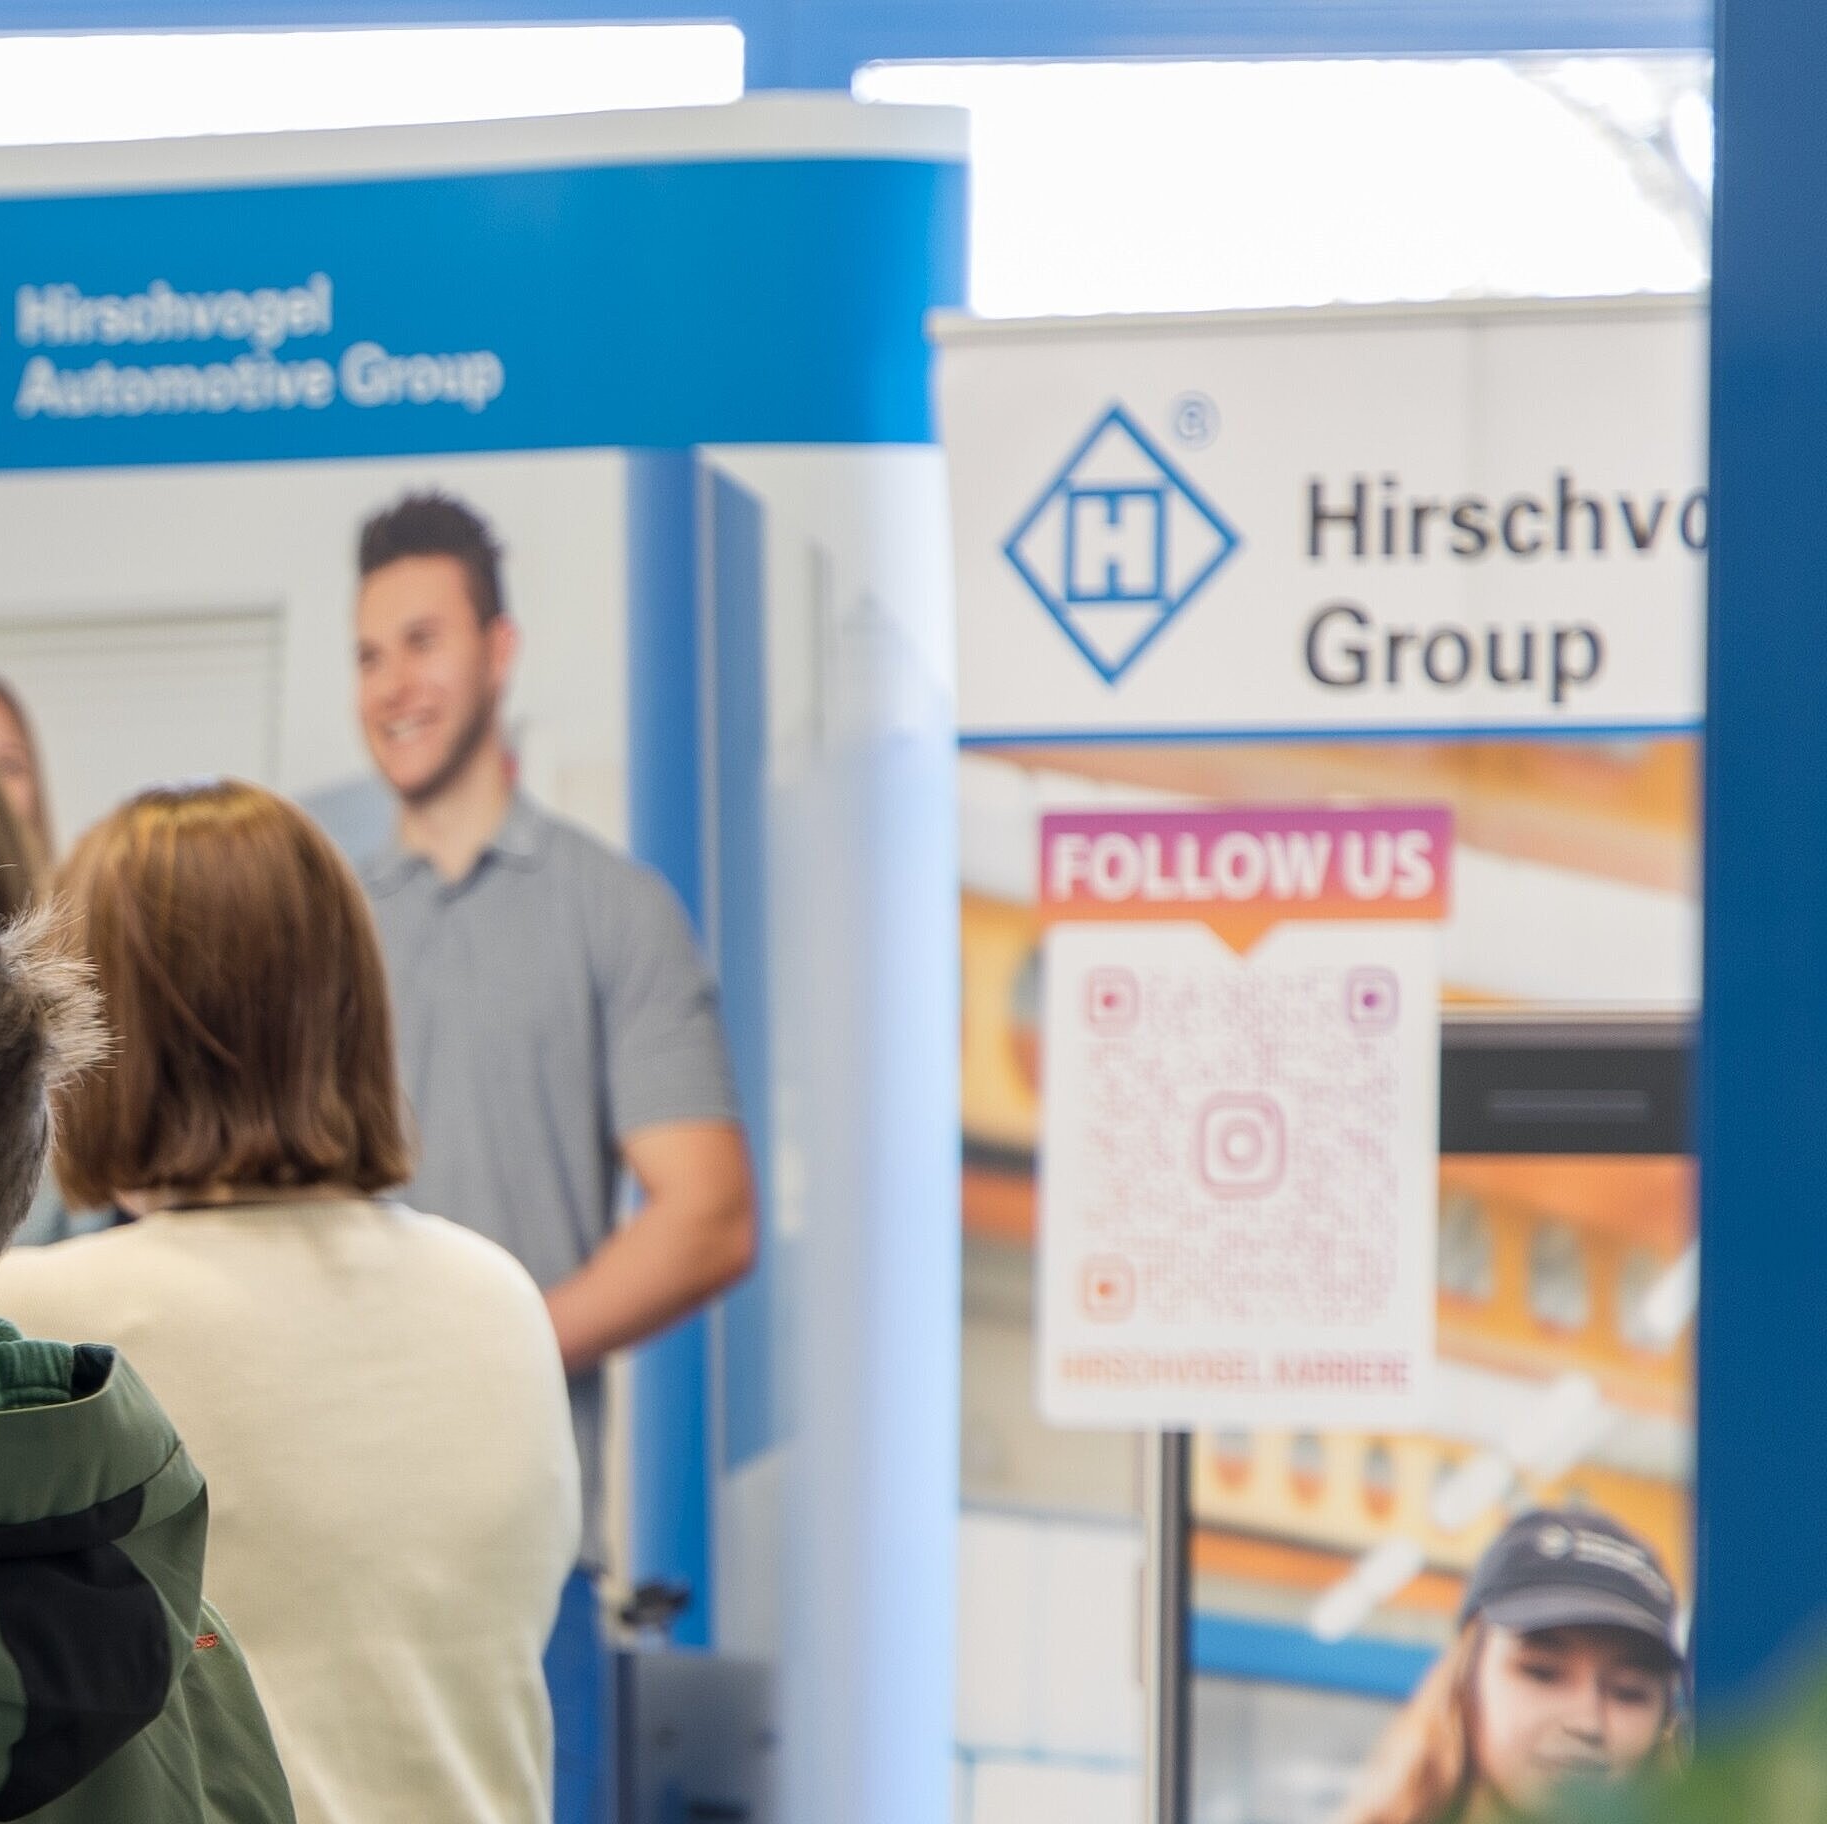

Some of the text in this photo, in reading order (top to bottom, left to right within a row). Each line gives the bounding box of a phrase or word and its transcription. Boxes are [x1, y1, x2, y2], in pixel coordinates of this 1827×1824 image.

[16, 273, 333, 349] Hirschvogel
[15, 342, 504, 418] Automotive Group
[1305, 602, 1604, 704] Group
[1052, 829, 1436, 902] FOLLOW US
